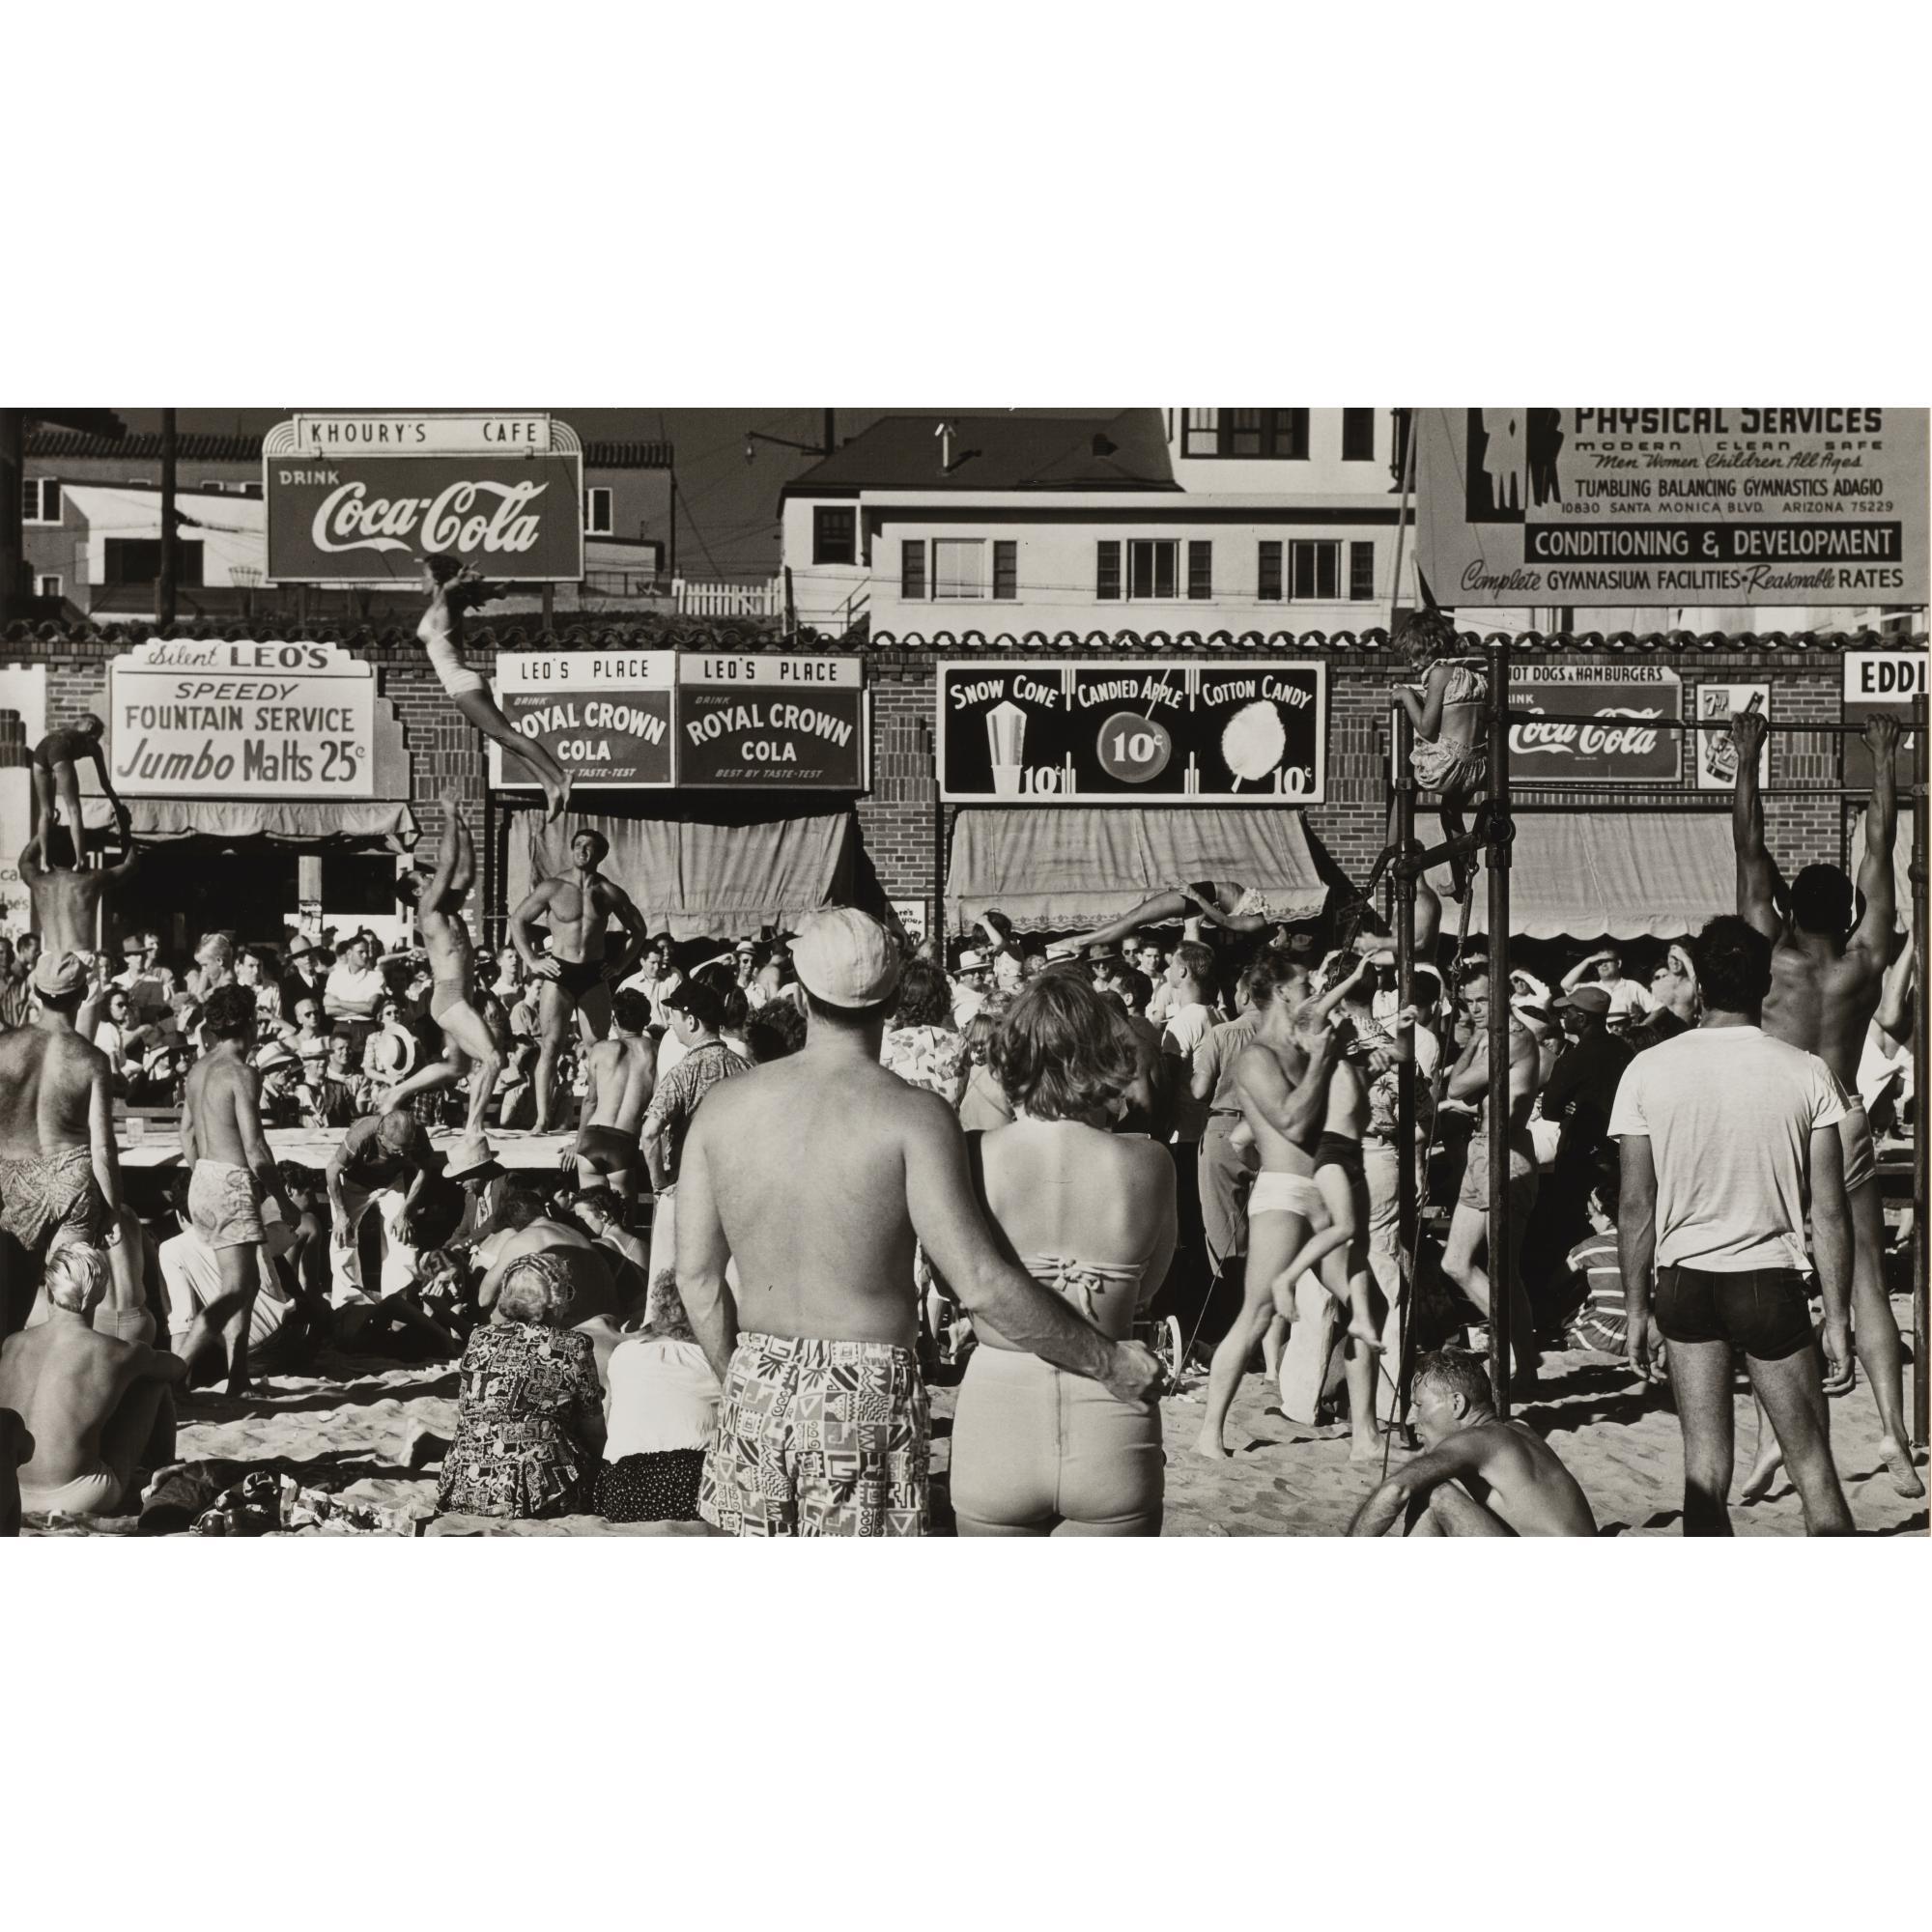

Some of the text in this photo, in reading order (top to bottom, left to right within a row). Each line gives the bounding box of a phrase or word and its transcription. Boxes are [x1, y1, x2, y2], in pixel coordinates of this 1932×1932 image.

[1575, 408, 1883, 434] PHYSICAL SERVICES
[311, 422, 537, 443] KHOURY'S CAFE
[1825, 440, 1883, 450] SAFE
[1590, 452, 1862, 474] Men Women Children All Ages
[279, 470, 340, 485] DRINK
[1575, 478, 1883, 497] TUMBLING BALANCING GYMNASTICS ADAGIO
[312, 481, 550, 553] Coca-Cola
[1562, 502, 1601, 514] 10830
[1609, 502, 1651, 513] SANTA
[1659, 502, 1721, 513] MONICA
[1782, 501, 1844, 513] ARIZONA
[1851, 500, 1893, 513] 75229
[1535, 529, 1893, 558] CONDITIONING & DEVELOPMENT
[1461, 559, 1904, 600] Complete GYMNASIUM FACILITIES Reasonable RATES
[146, 643, 328, 669] Silent LEO'S
[522, 658, 648, 679] LEO'S PLACE
[704, 658, 837, 681] LEO'S PLACE
[1533, 667, 1565, 681] DOGS
[1576, 667, 1662, 682] HAMBURGERS
[1861, 661, 1925, 694] EDDI
[175, 682, 299, 700] SPEEDY
[513, 696, 550, 706] DRINK
[695, 696, 731, 705] DRINK
[950, 674, 1060, 710] SNOW CONE
[1077, 675, 1184, 710] CANDIED APPLE
[1202, 674, 1313, 710] COTTON CANDY
[1508, 694, 1535, 704] INK
[125, 705, 355, 732] FOUNTAIN SERVICE
[583, 701, 668, 746] CROWN
[686, 703, 853, 748] ROYAL CROWN
[1508, 707, 1664, 754] CocaCola
[117, 737, 235, 781] Jumbo
[242, 738, 314, 782] Malts
[556, 740, 611, 761] COLA
[741, 740, 798, 762] COLA
[578, 768, 637, 778] TASTE-TEST
[715, 769, 824, 779] BEST BY TASTE-TEST
